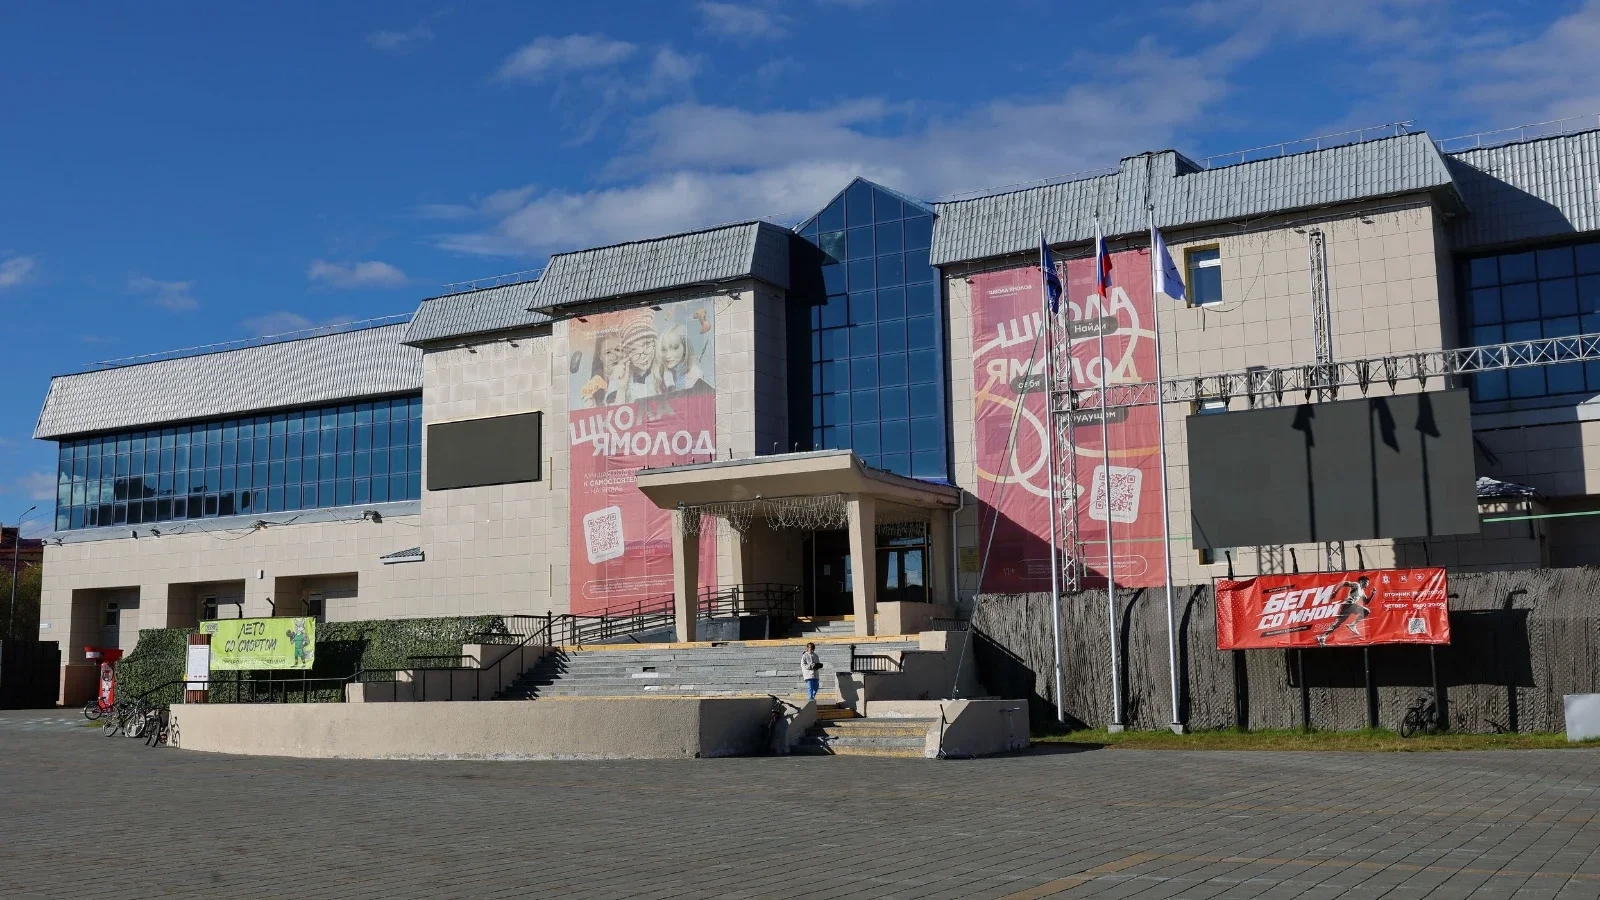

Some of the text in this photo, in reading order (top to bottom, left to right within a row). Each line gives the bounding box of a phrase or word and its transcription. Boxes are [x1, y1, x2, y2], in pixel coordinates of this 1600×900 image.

[592, 430, 716, 456] ЯМОЛОД
[1260, 584, 1336, 615] БЕГИ
[238, 621, 266, 639] ЛЕТО
[1255, 612, 1286, 631] СО
[225, 639, 236, 653] СО
